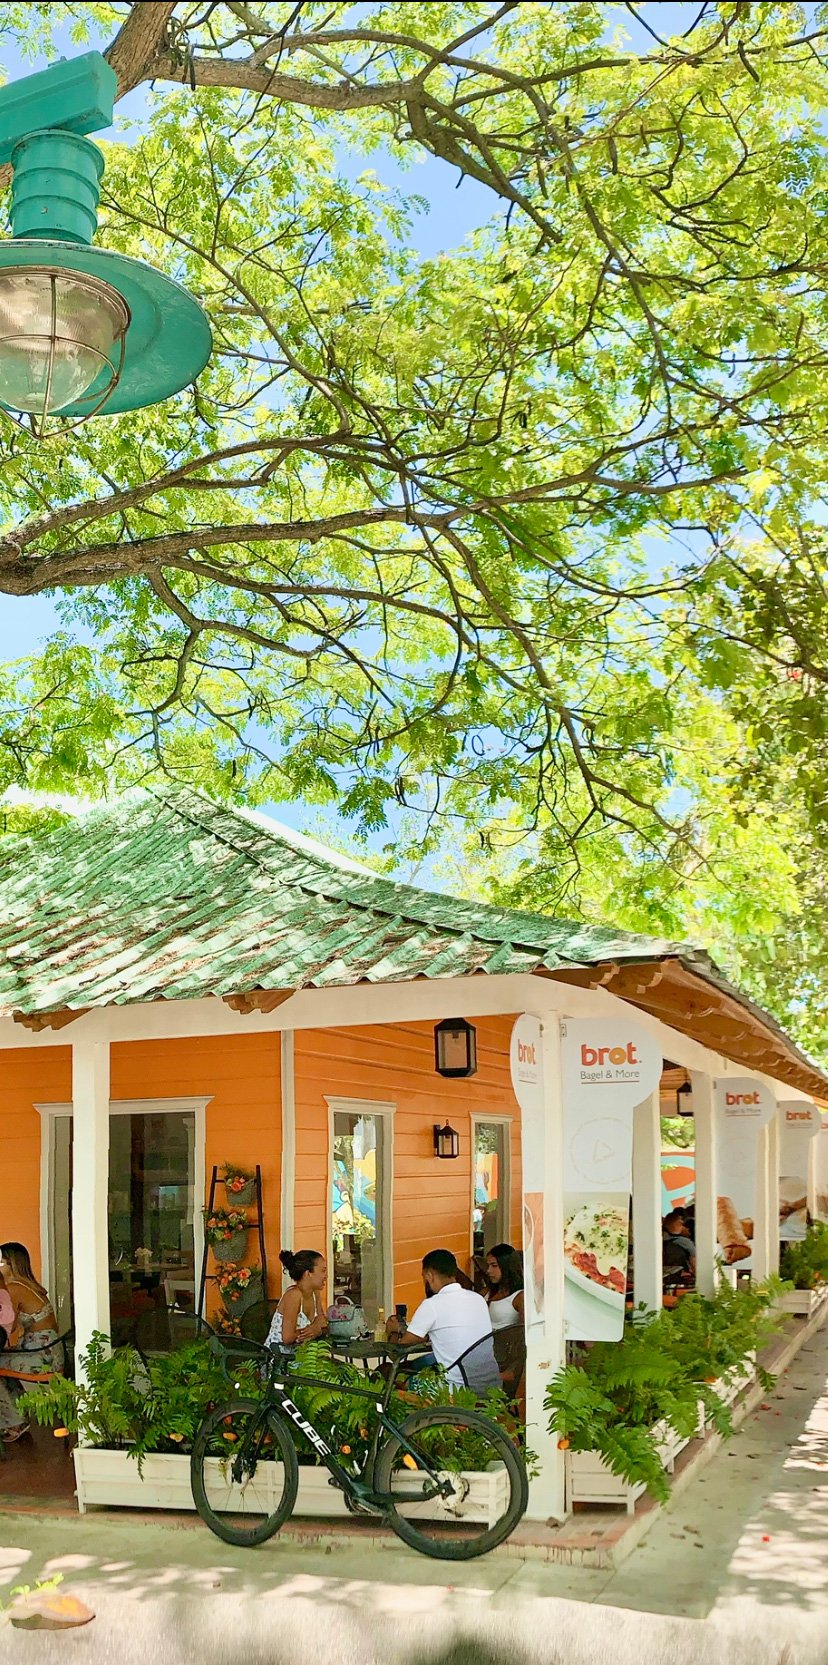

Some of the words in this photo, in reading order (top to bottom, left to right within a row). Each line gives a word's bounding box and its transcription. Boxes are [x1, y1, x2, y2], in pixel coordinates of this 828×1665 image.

[518, 1039, 536, 1065] brot
[581, 1042, 638, 1066] brot
[580, 1070, 604, 1082] Bagel
[605, 1069, 613, 1079] &
[615, 1069, 640, 1079] More
[726, 1091, 760, 1105] brot
[281, 1399, 332, 1456] CUBE
